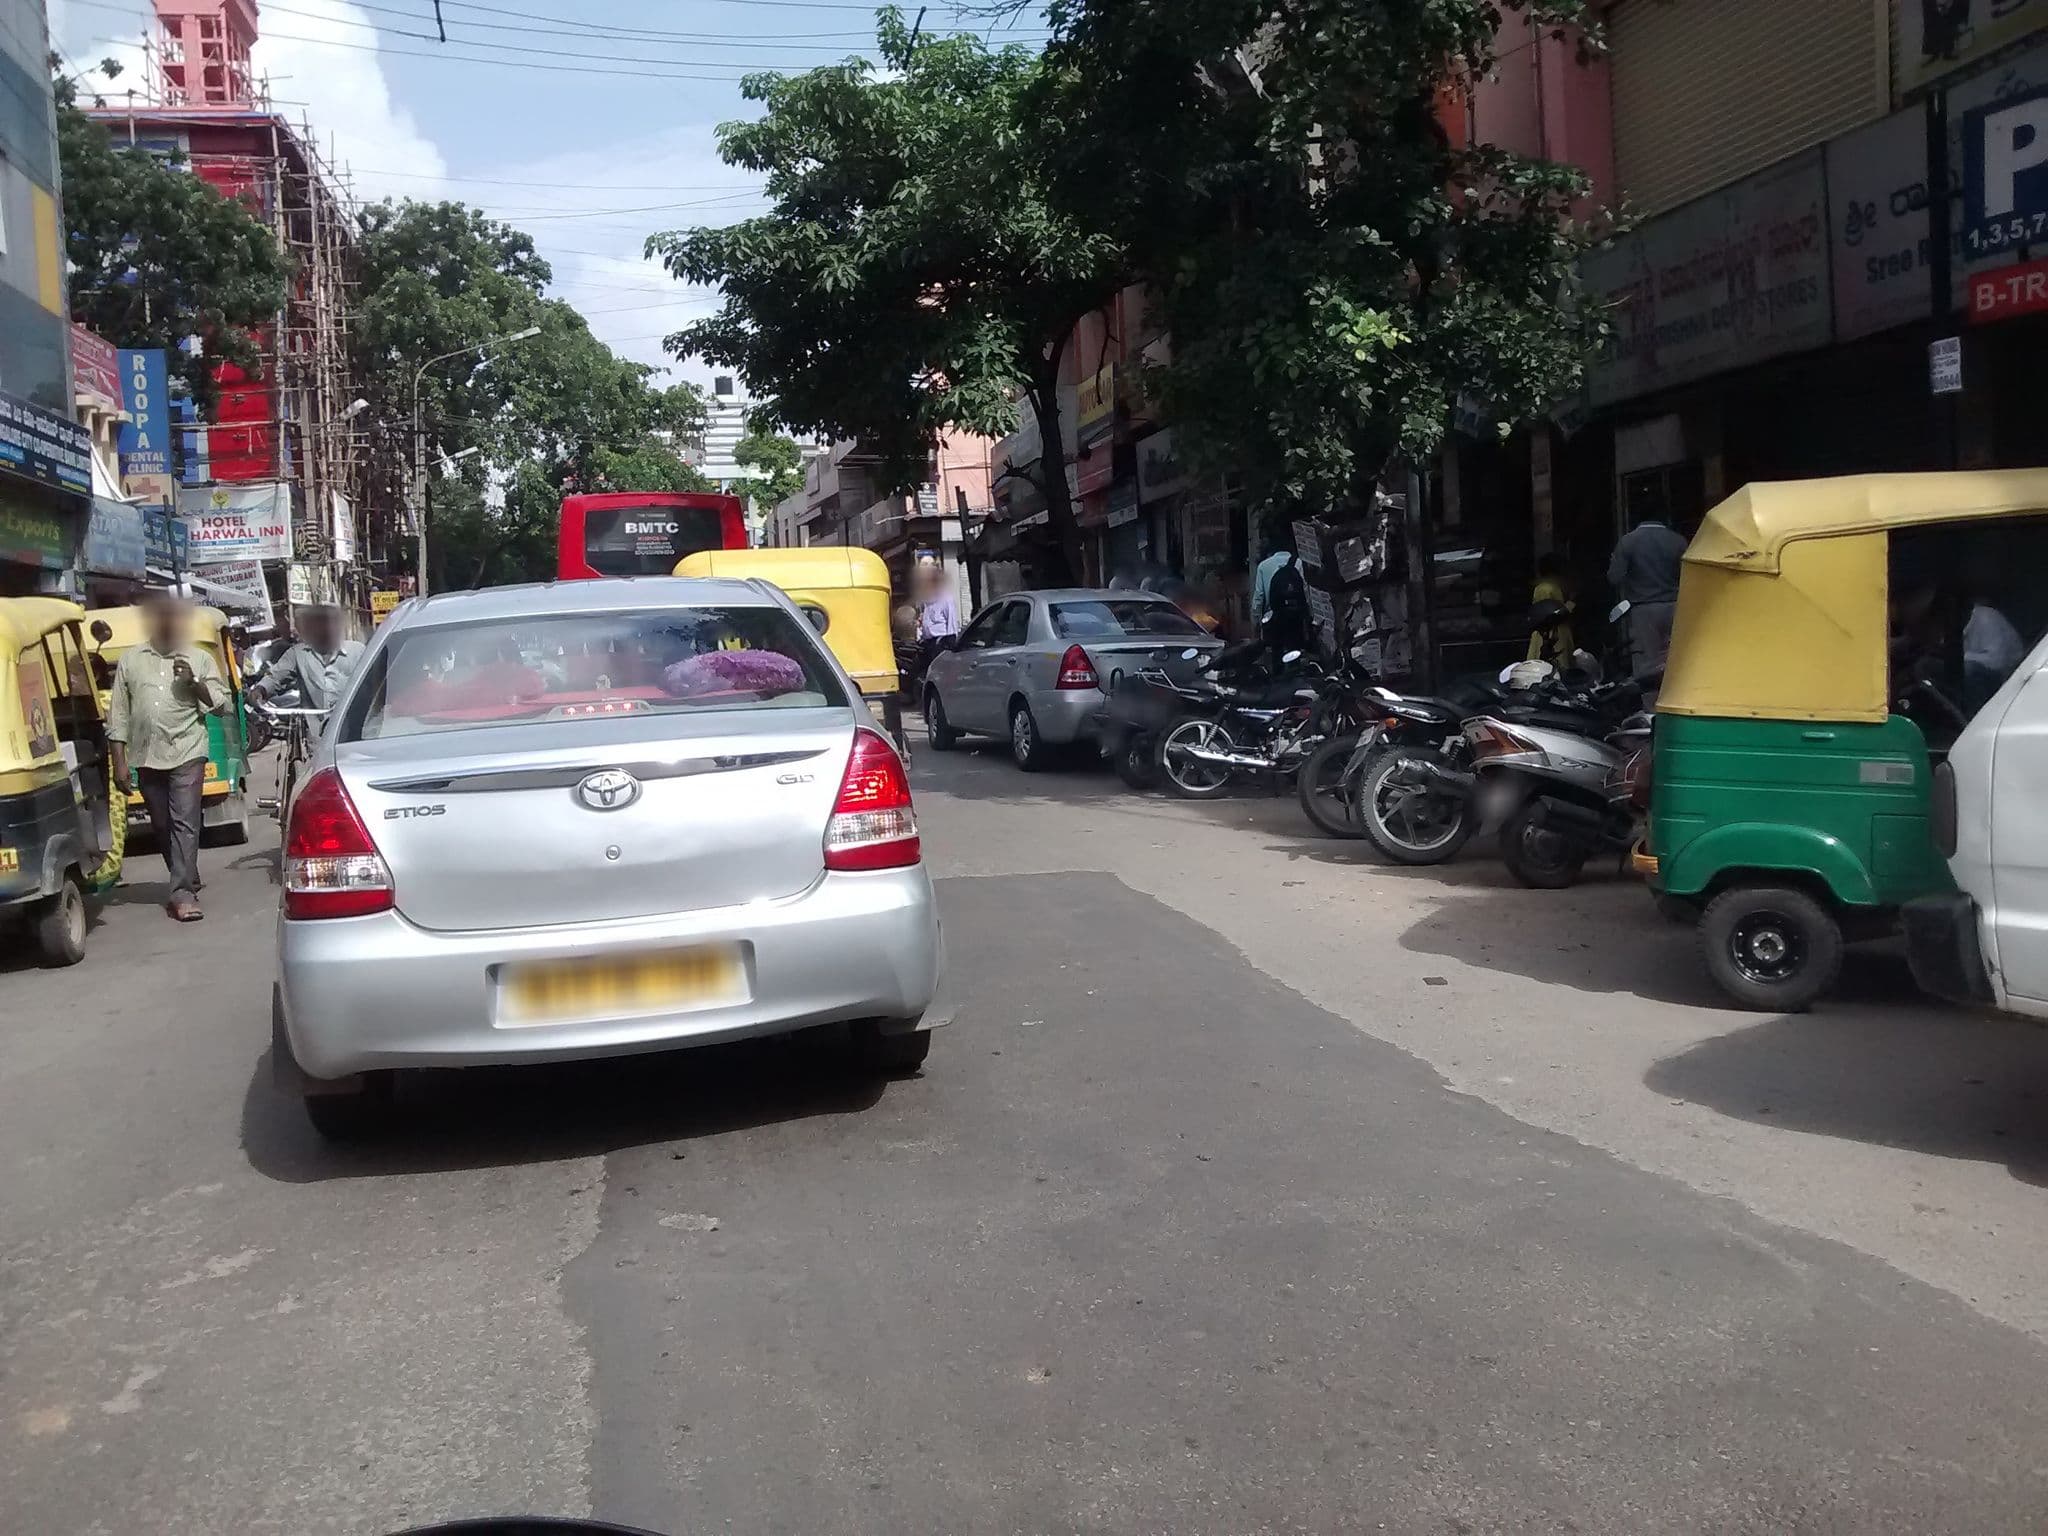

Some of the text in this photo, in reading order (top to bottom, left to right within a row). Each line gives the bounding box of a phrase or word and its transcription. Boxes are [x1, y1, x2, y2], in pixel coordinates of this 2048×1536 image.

[1983, 97, 2048, 218] P
[1867, 249, 1912, 284] Sree
[132, 354, 150, 449] ROOPA
[128, 463, 164, 473] CLINIC
[7, 511, 61, 541] Exports
[201, 515, 246, 528] HOTEL
[624, 522, 679, 534] BMTC
[190, 528, 255, 540] HARWAL
[259, 526, 284, 537] INN
[384, 804, 446, 820] ETIOS
